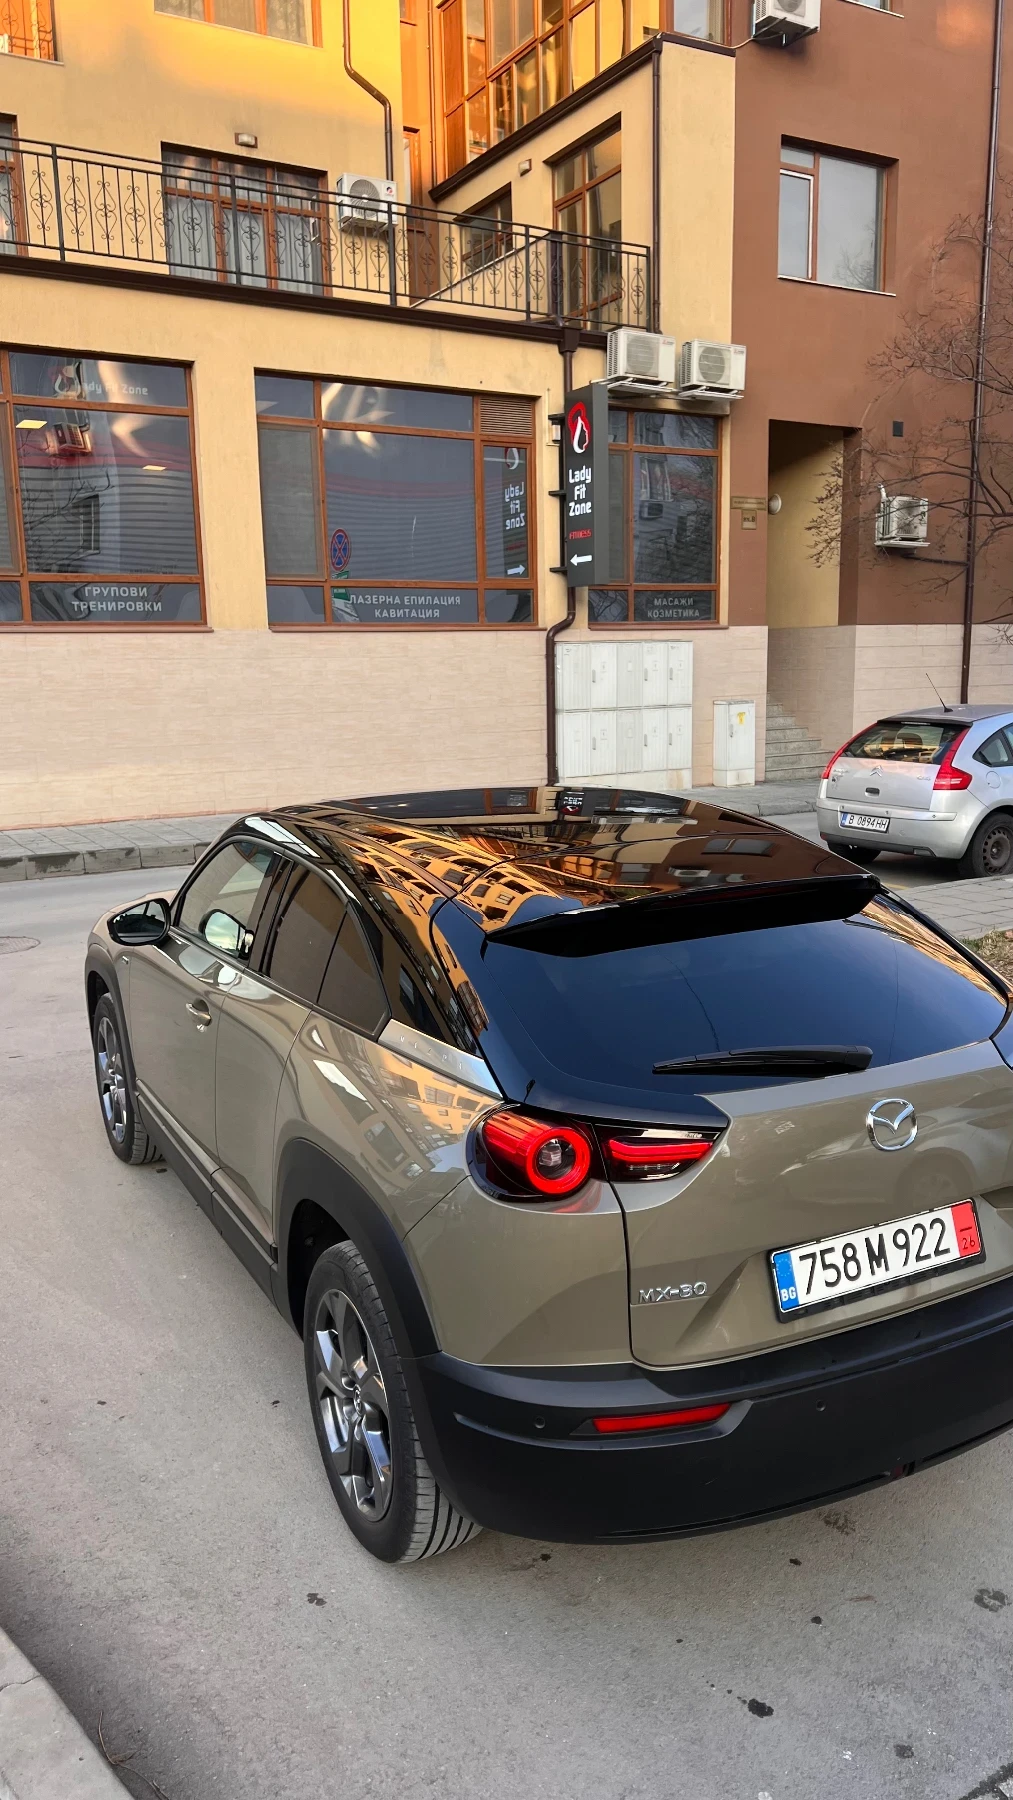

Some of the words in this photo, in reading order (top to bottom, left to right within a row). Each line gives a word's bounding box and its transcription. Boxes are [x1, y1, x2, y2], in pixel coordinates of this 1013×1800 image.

[121, 383, 149, 396] Zone
[568, 465, 592, 484] Lady
[574, 484, 587, 501] Fit
[569, 501, 592, 517] Zone
[84, 586, 148, 597] ГРУПОВИ
[349, 594, 401, 605] ЛАЗЕРНА
[404, 596, 461, 606] ЕПИЛАЦИЯ
[653, 597, 694, 606] МАСАЖИ
[71, 601, 162, 612] ТРЕНИРОВКИ
[374, 608, 440, 619] КАВИТАЦИЯ
[647, 609, 700, 618] КОЗМЕТИКА
[780, 1287, 797, 1302] BG
[799, 1242, 862, 1296] 758
[864, 1233, 890, 1276] M
[892, 1217, 951, 1268] 922
[961, 1234, 976, 1250] 26
[639, 1281, 708, 1304] MX-30
